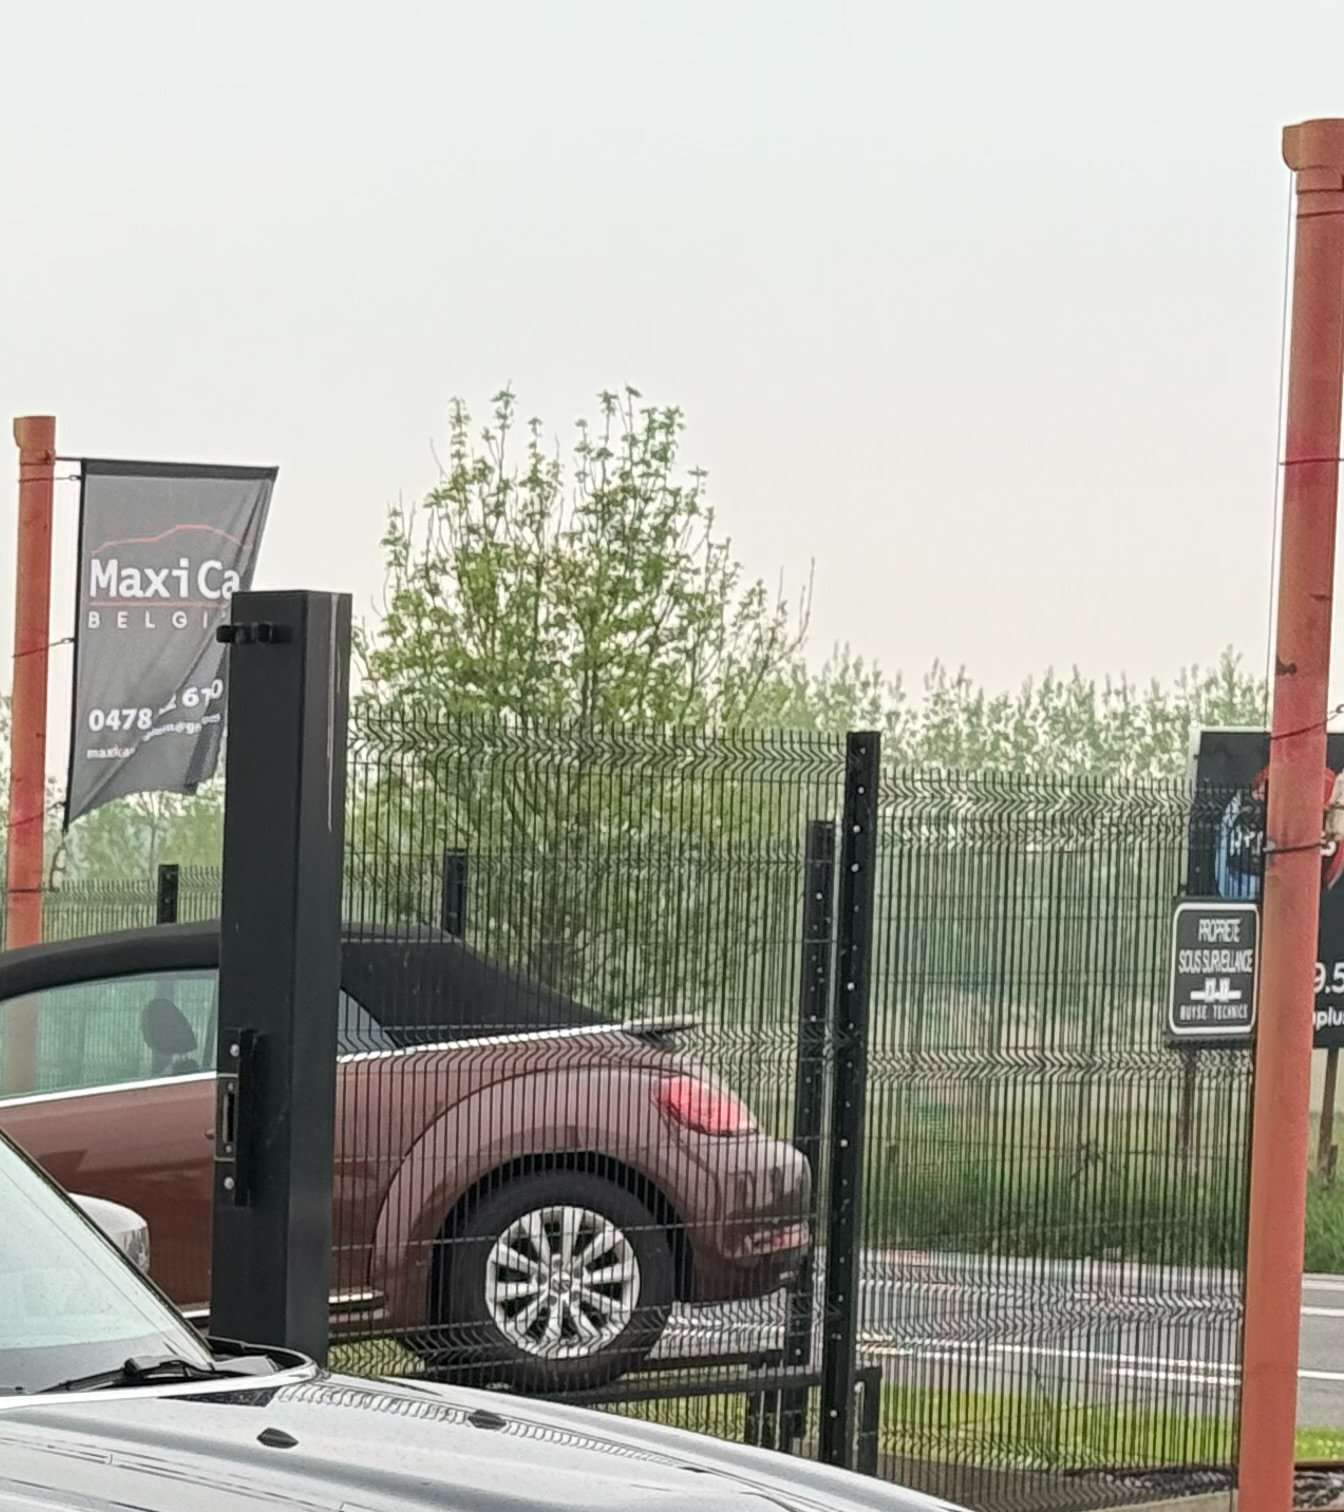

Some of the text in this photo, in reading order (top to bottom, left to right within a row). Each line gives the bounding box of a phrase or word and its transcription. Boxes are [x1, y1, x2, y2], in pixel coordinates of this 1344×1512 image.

[89, 557, 190, 599] Maxi
[88, 605, 229, 630] BELGI
[88, 707, 153, 732] 0478
